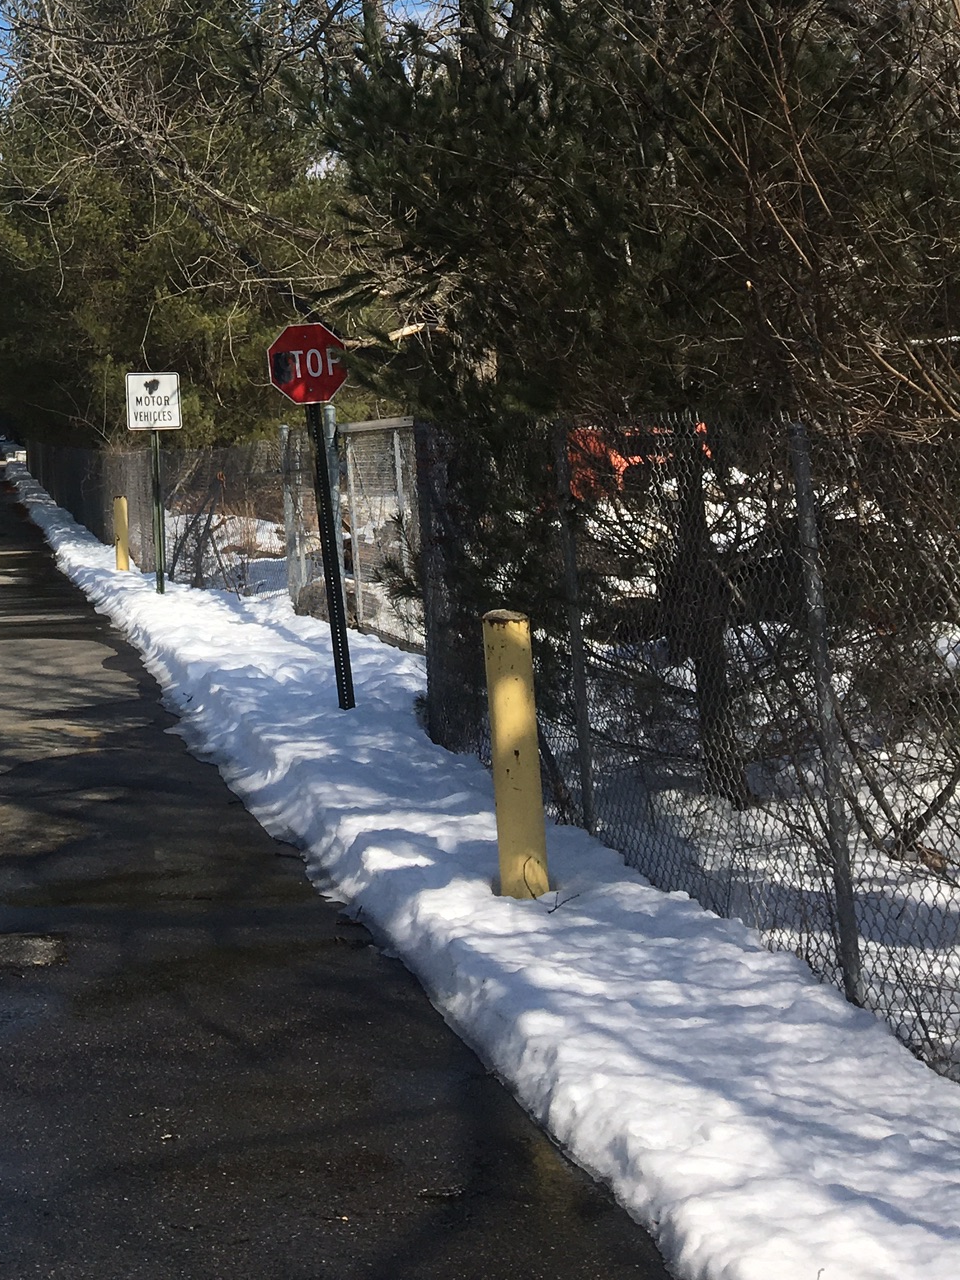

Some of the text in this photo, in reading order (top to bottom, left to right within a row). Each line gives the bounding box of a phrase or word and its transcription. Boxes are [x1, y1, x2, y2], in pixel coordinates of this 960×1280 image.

[280, 348, 342, 379] TOP
[135, 395, 170, 407] MOTOR
[134, 410, 172, 422] VEHICLES
